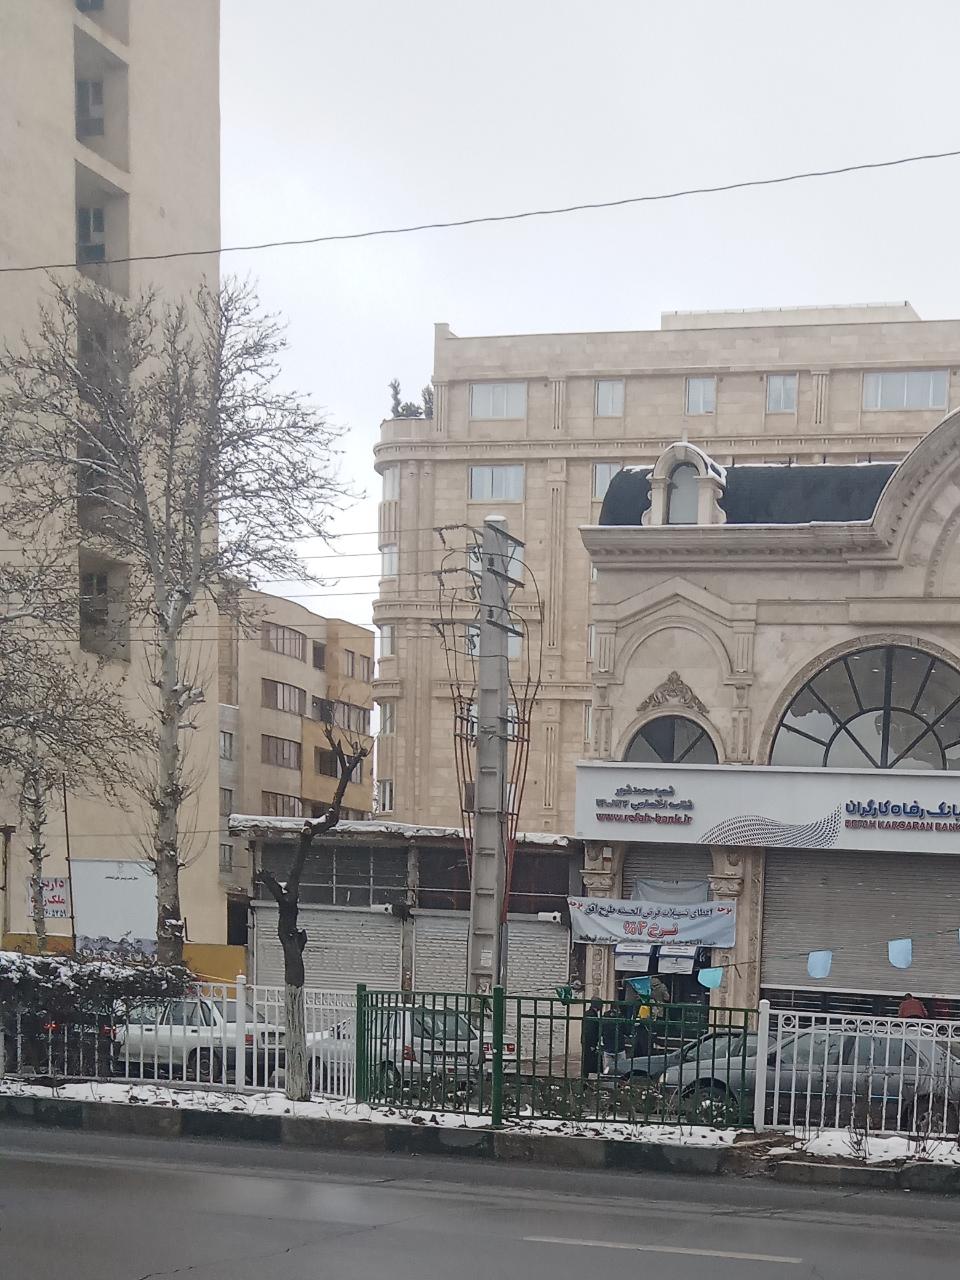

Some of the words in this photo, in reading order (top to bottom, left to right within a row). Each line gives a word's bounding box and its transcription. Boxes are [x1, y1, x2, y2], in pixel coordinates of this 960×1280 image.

[845, 799, 891, 818] کارگران
[891, 800, 926, 820] رفاه
[596, 813, 693, 825] www.refah-bank.ir
[844, 819, 877, 830] REFAH
[877, 820, 934, 832] KARGARAN
[647, 921, 679, 938] نرخ
